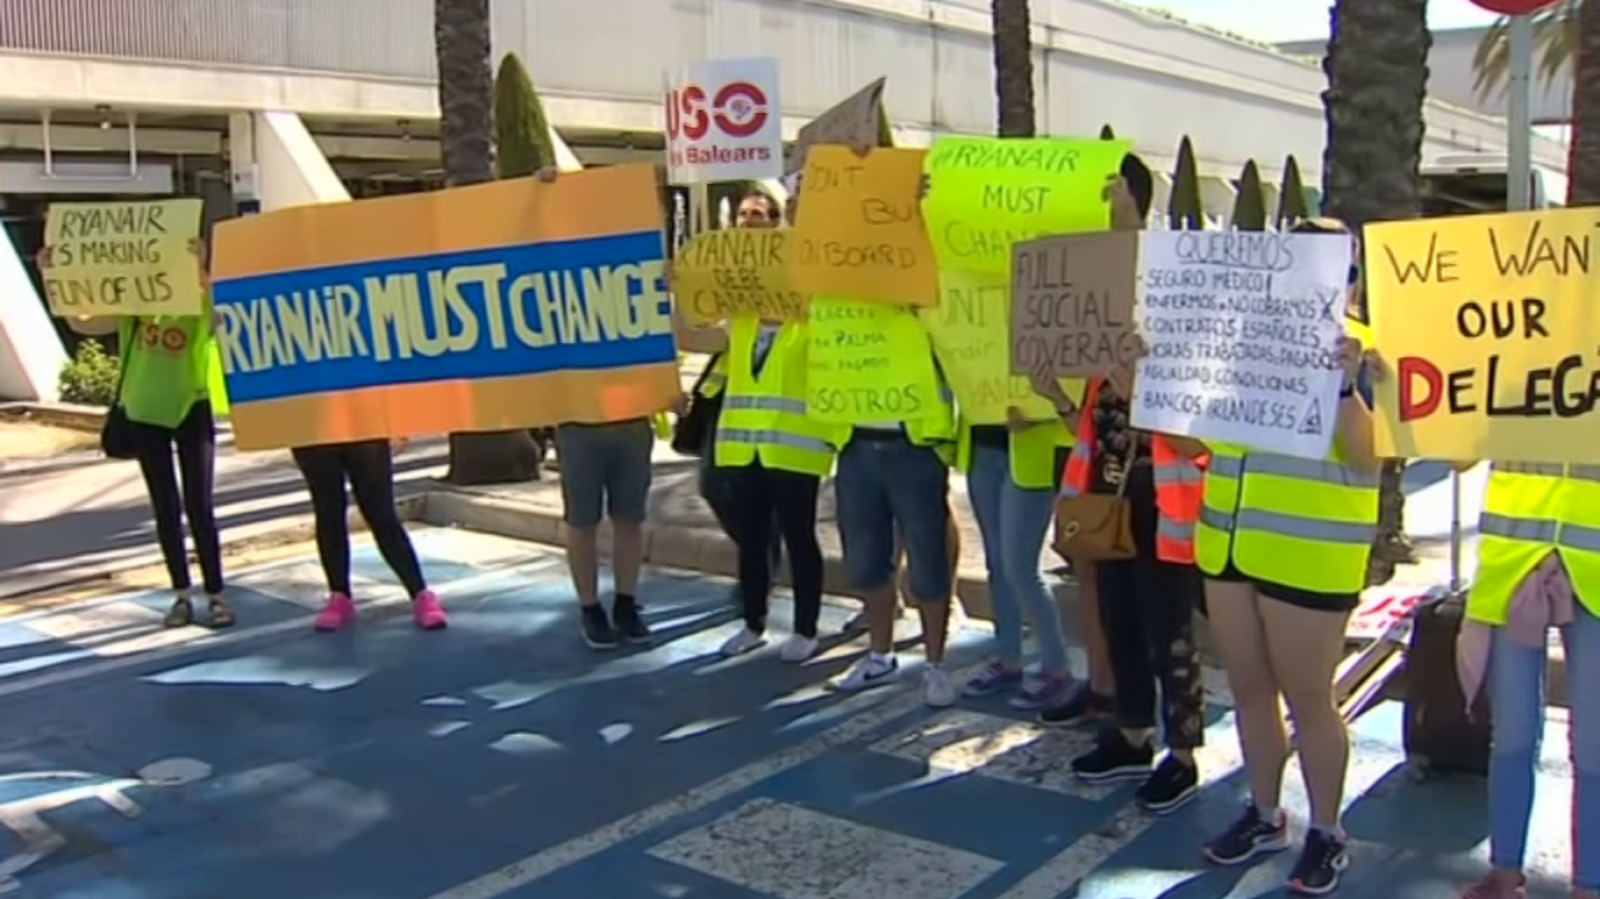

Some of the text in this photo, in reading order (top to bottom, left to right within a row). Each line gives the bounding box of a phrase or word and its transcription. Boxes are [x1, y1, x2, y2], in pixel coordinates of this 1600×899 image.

[666, 82, 768, 141] USO
[981, 184, 1051, 213] MUST
[60, 205, 167, 240] RYANAIR
[80, 238, 161, 265] MAKING
[1016, 247, 1073, 290] FULL
[1175, 232, 1295, 272] QUEREMOS
[1383, 219, 1600, 285] WE WAN
[47, 271, 173, 307] FUN OF US
[1145, 267, 1206, 289] SEGURO
[364, 263, 507, 361] MUST
[508, 260, 673, 347] CHANGE
[1023, 290, 1124, 330] SOCIAL
[1457, 297, 1550, 339] OUR
[1143, 390, 1202, 415] BANCOS
